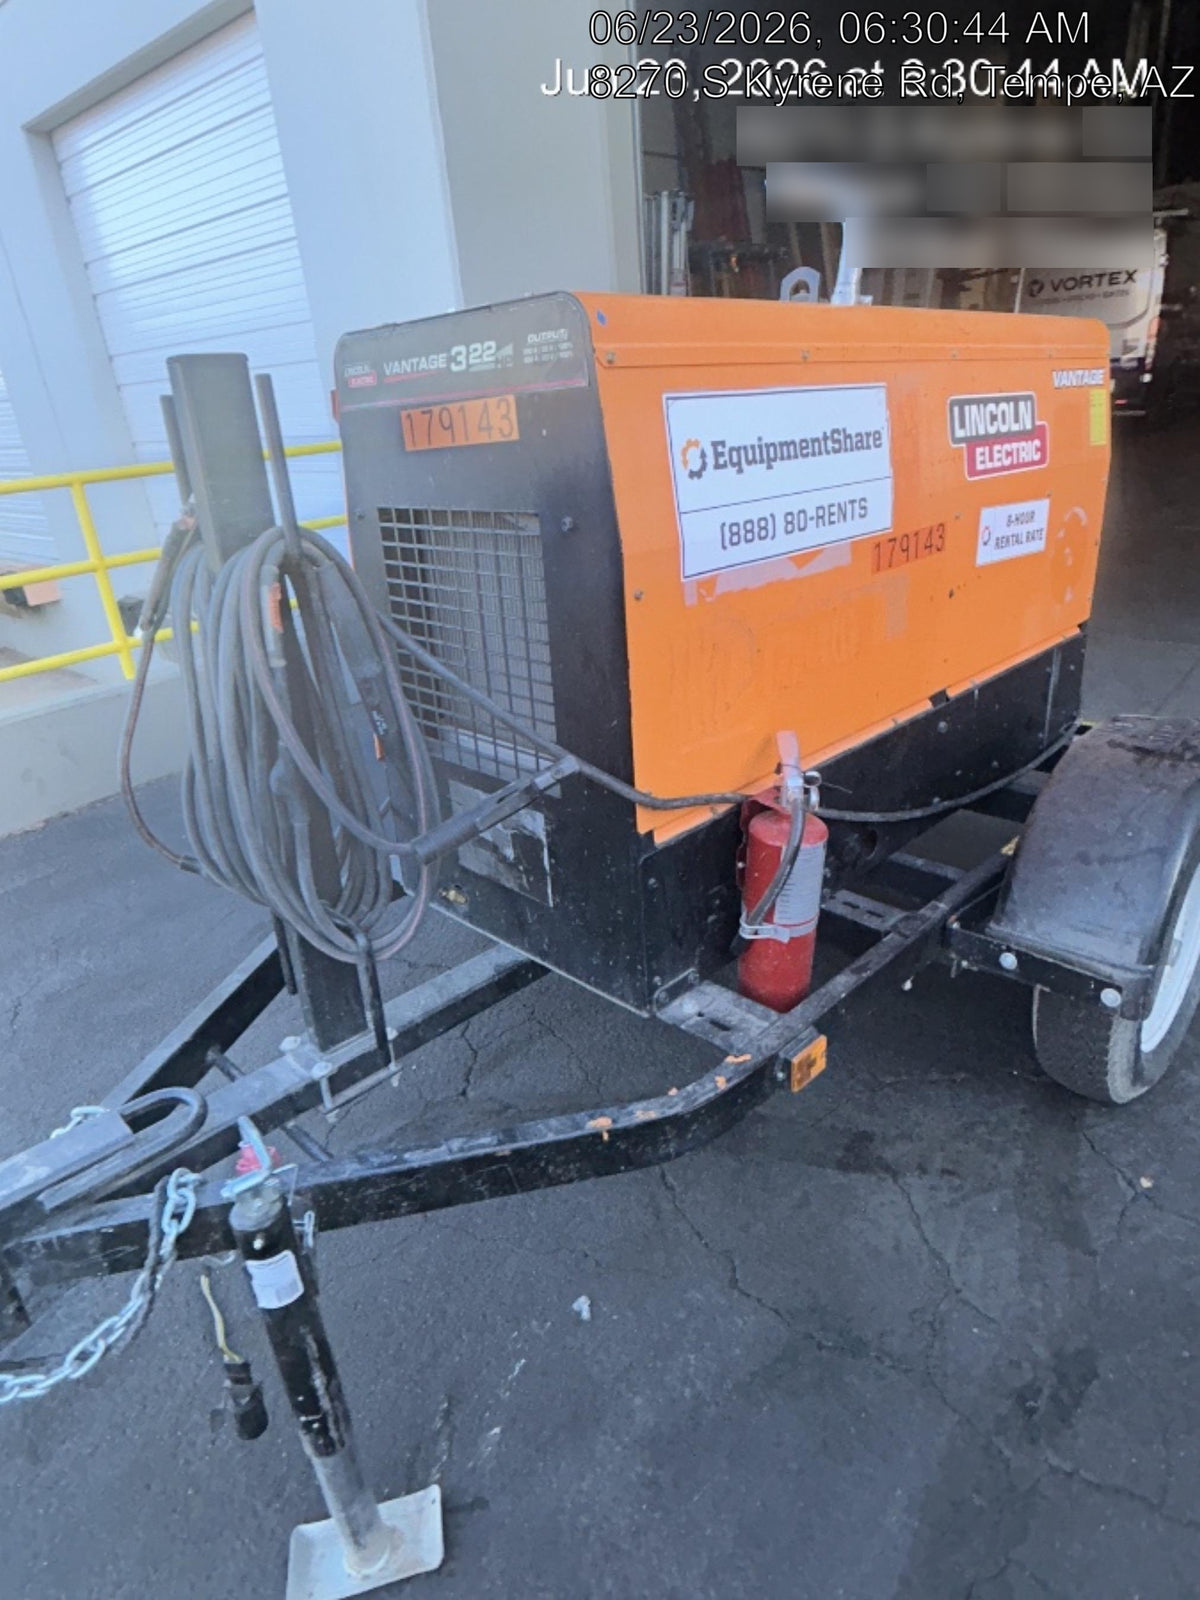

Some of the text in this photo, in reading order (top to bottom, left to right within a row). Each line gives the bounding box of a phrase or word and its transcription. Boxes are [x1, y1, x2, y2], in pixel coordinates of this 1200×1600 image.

[1051, 269, 1138, 293] VORTEX
[383, 353, 447, 376] VANTAGE
[450, 340, 496, 372] 322
[1052, 369, 1105, 388] VANTAGE
[405, 396, 514, 447] 179143
[953, 400, 1032, 438] LINCOLN
[711, 428, 883, 474] EquipmentShare
[975, 438, 1042, 471] ELECTRIC
[720, 497, 868, 550] (888) 80-RENTS
[994, 527, 1044, 551] RENTAL RATE
[874, 522, 946, 572] 179143
